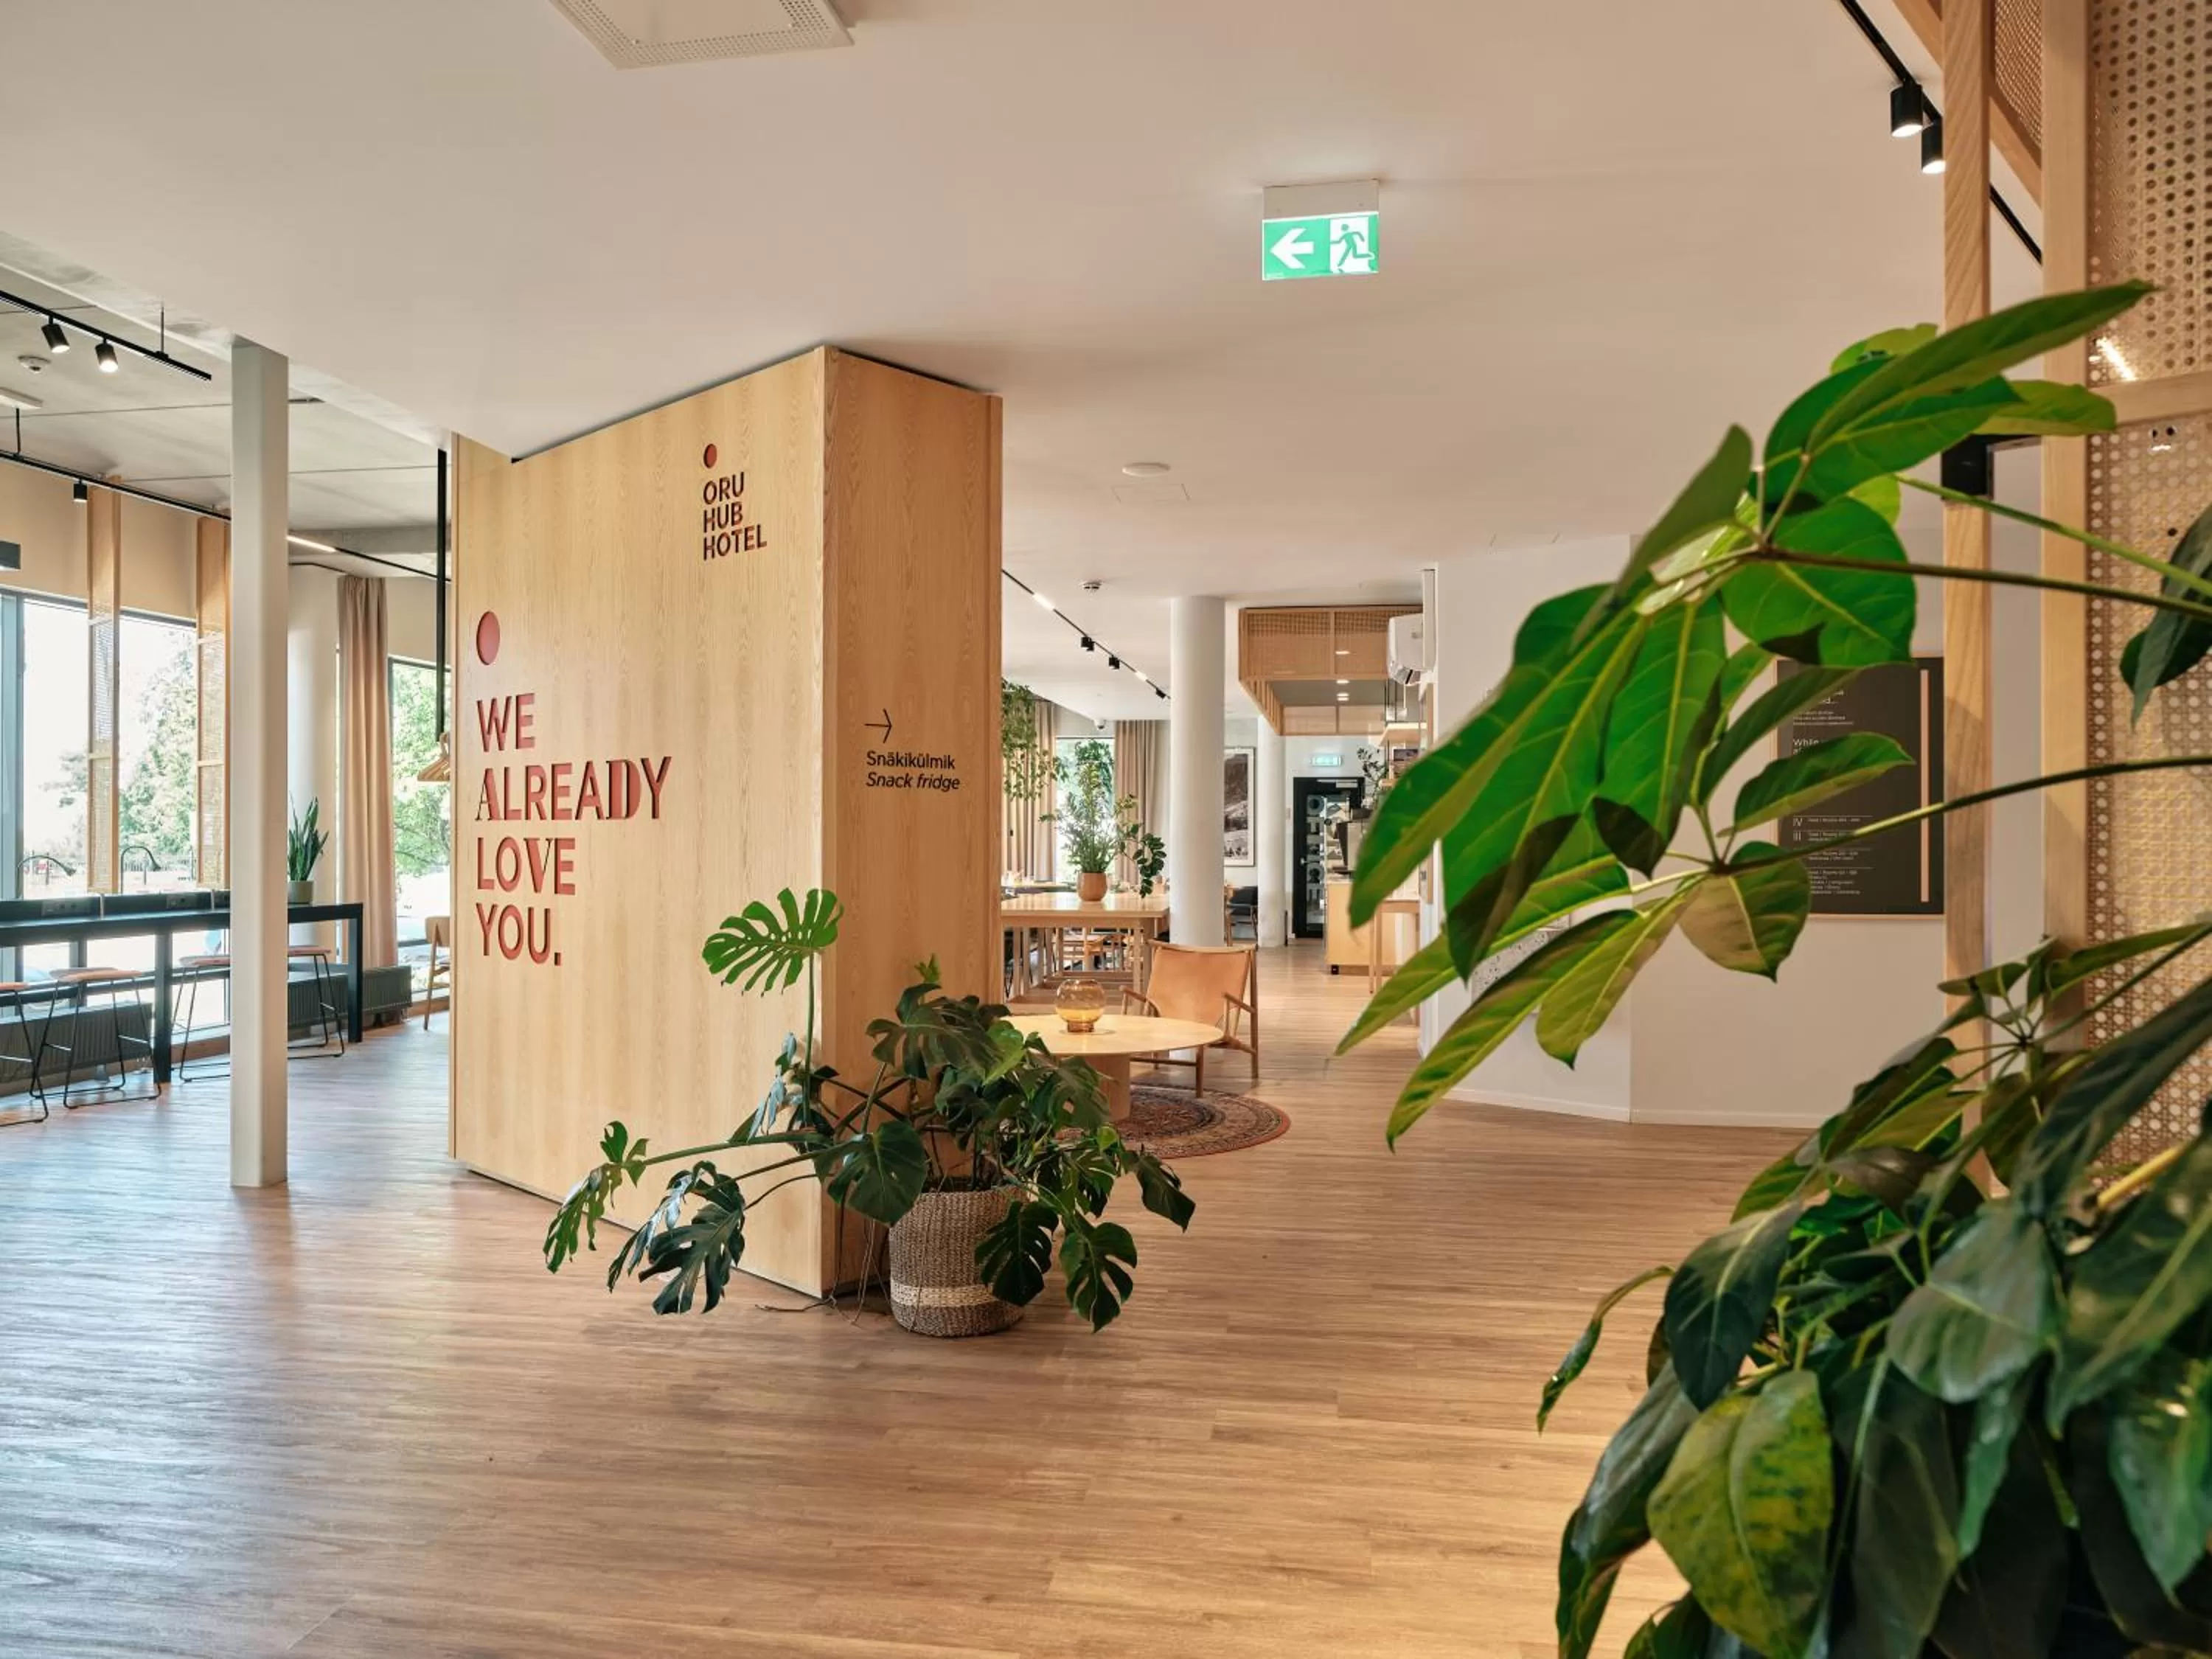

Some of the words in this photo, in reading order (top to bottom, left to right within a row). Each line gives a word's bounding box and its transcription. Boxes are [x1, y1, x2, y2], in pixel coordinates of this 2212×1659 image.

[703, 471, 744, 505] ORU
[703, 501, 743, 533] HUB
[703, 524, 767, 561] HOTEL
[477, 692, 535, 752] WE
[866, 750, 956, 769] Snäkikülmik
[475, 756, 672, 821] ALREADY
[866, 771, 913, 788] Snack
[917, 773, 961, 793] fridge
[477, 836, 575, 895] LOVE
[476, 902, 561, 966] YOU.
